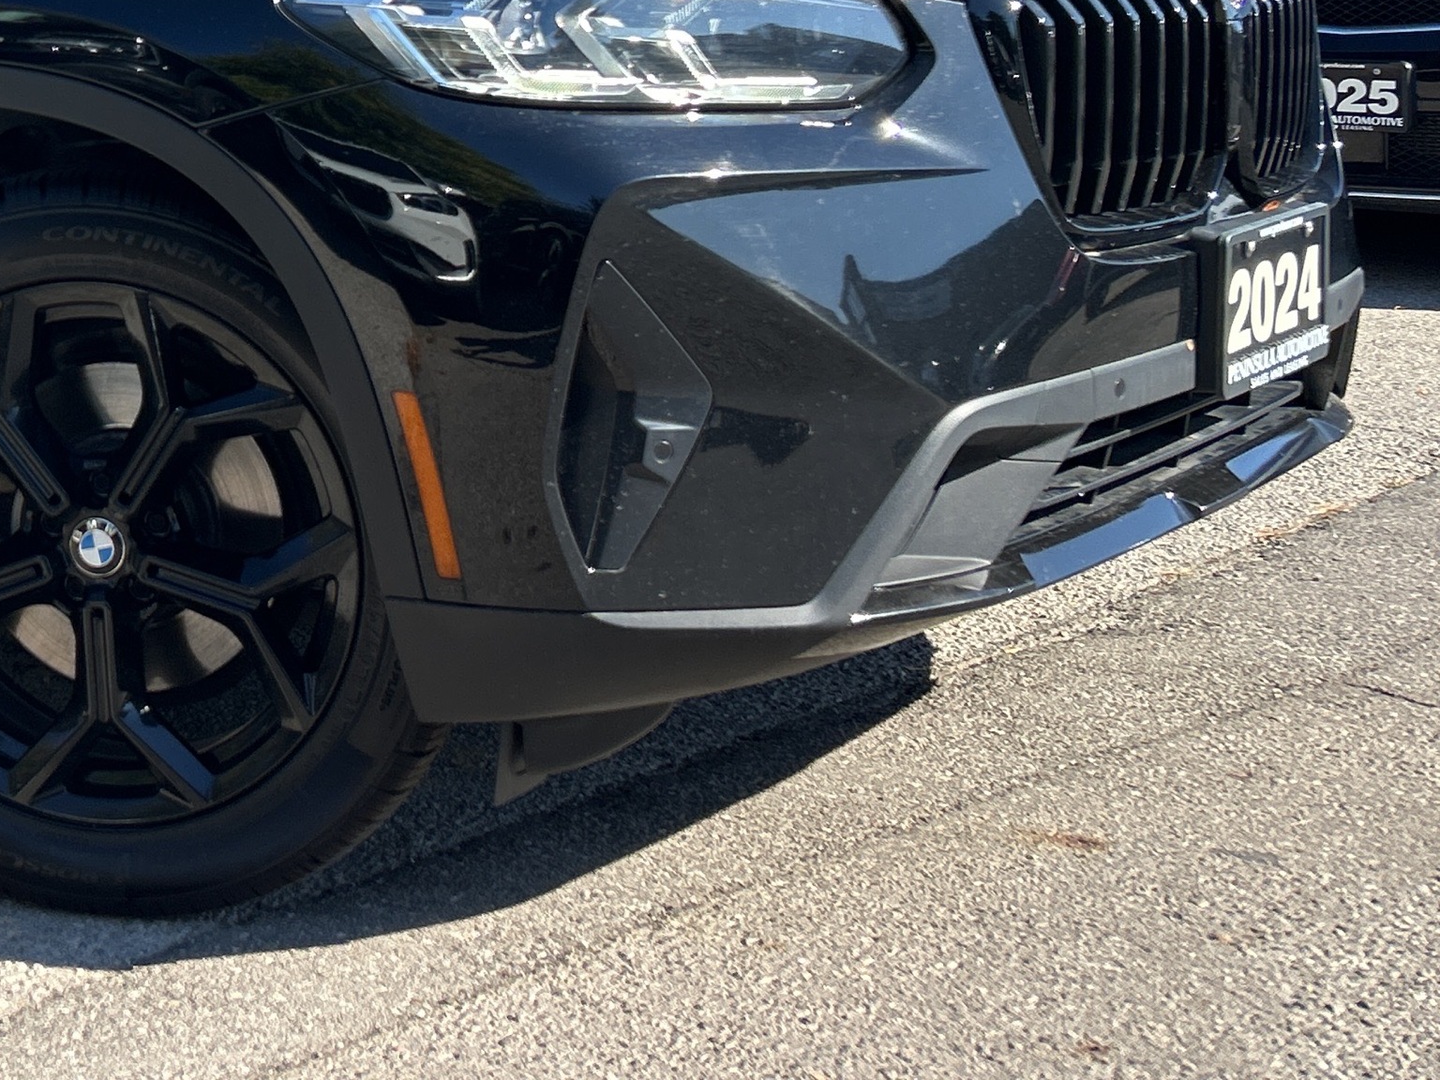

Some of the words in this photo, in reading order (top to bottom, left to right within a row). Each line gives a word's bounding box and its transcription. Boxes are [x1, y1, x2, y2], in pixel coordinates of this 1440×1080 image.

[42, 226, 282, 316] CONTINENTAL
[1227, 244, 1322, 355] 2024
[72, 519, 117, 543] BMW
